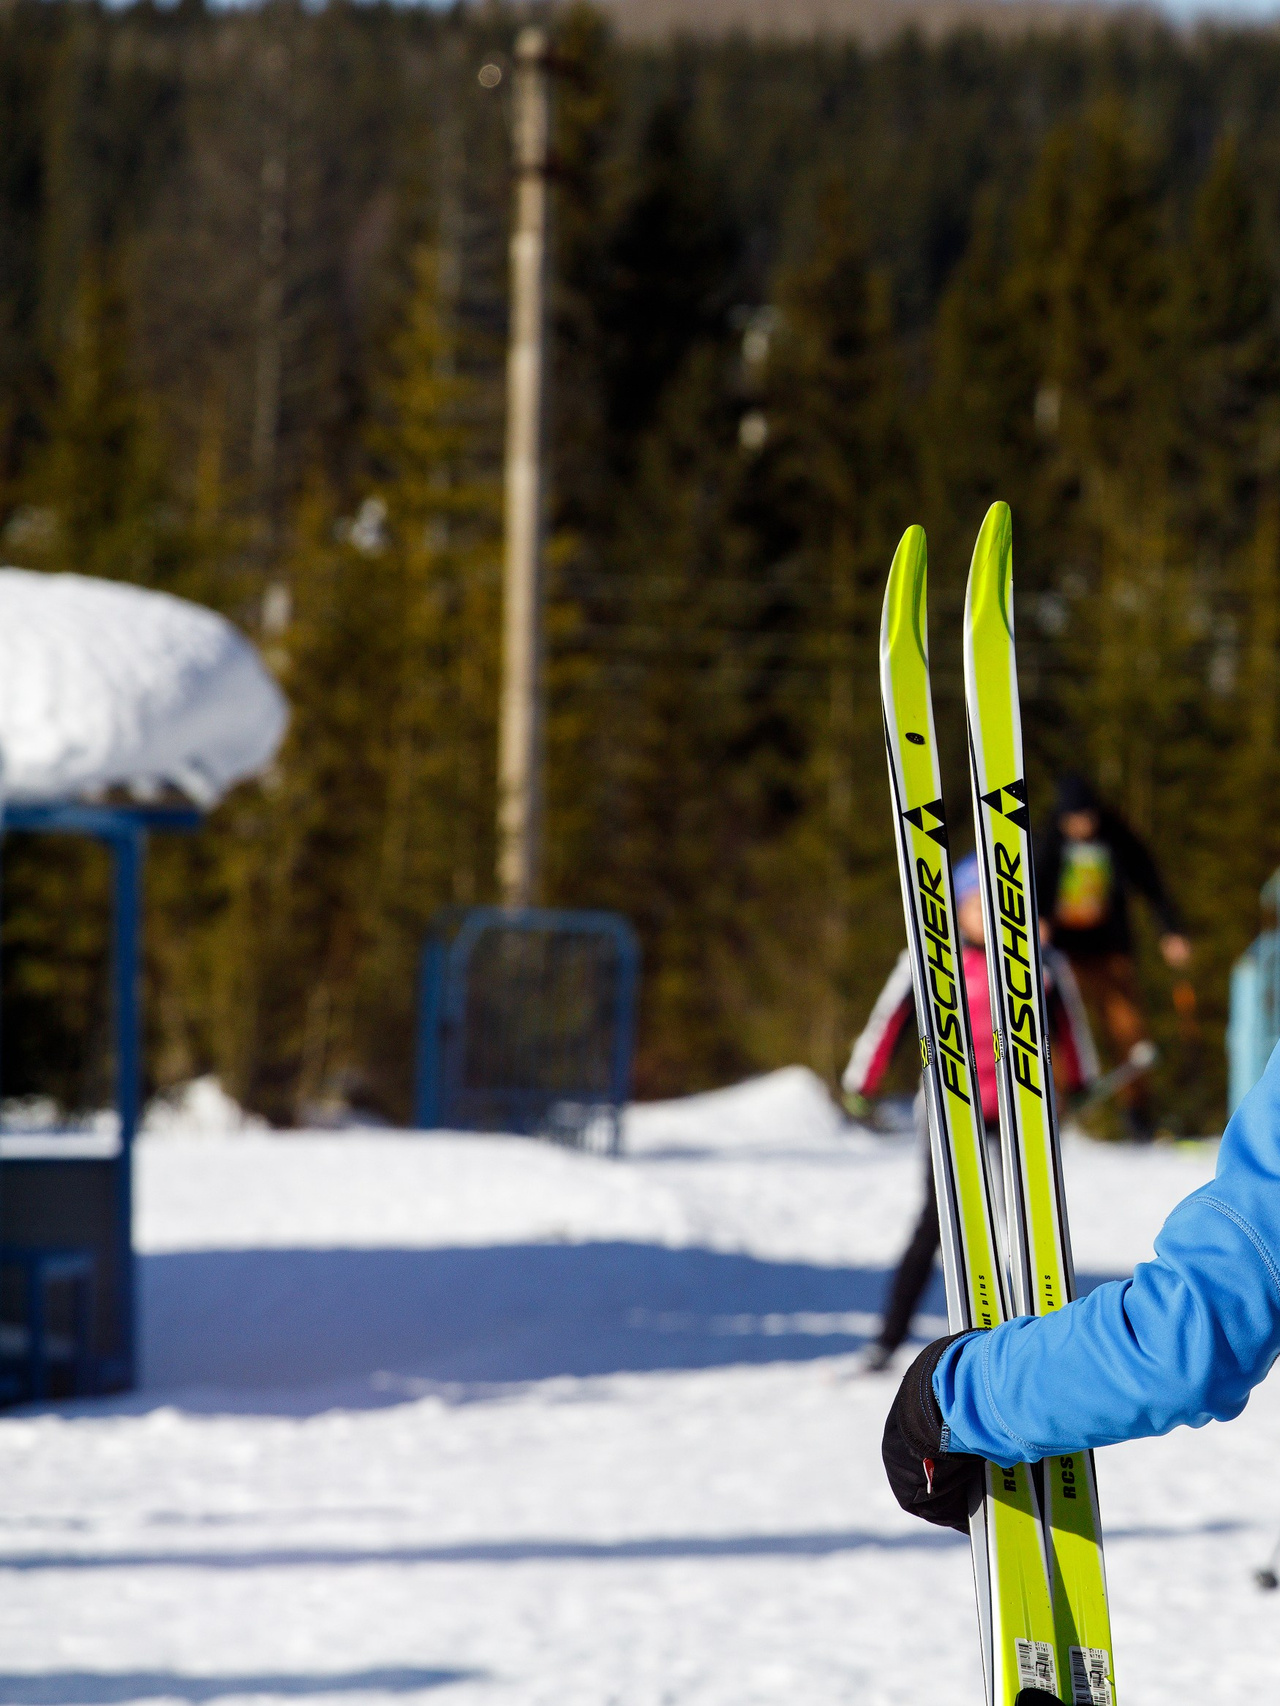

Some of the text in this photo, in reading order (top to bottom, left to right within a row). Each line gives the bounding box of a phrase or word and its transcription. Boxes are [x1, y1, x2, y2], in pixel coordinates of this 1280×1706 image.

[917, 857, 971, 1106] FISCHER
[994, 841, 1043, 1099] FISCHER
[978, 1275, 989, 1306] plus
[1044, 1275, 1055, 1306] plus
[1002, 1467, 1017, 1492] RC
[1060, 1456, 1077, 1499] RCS
